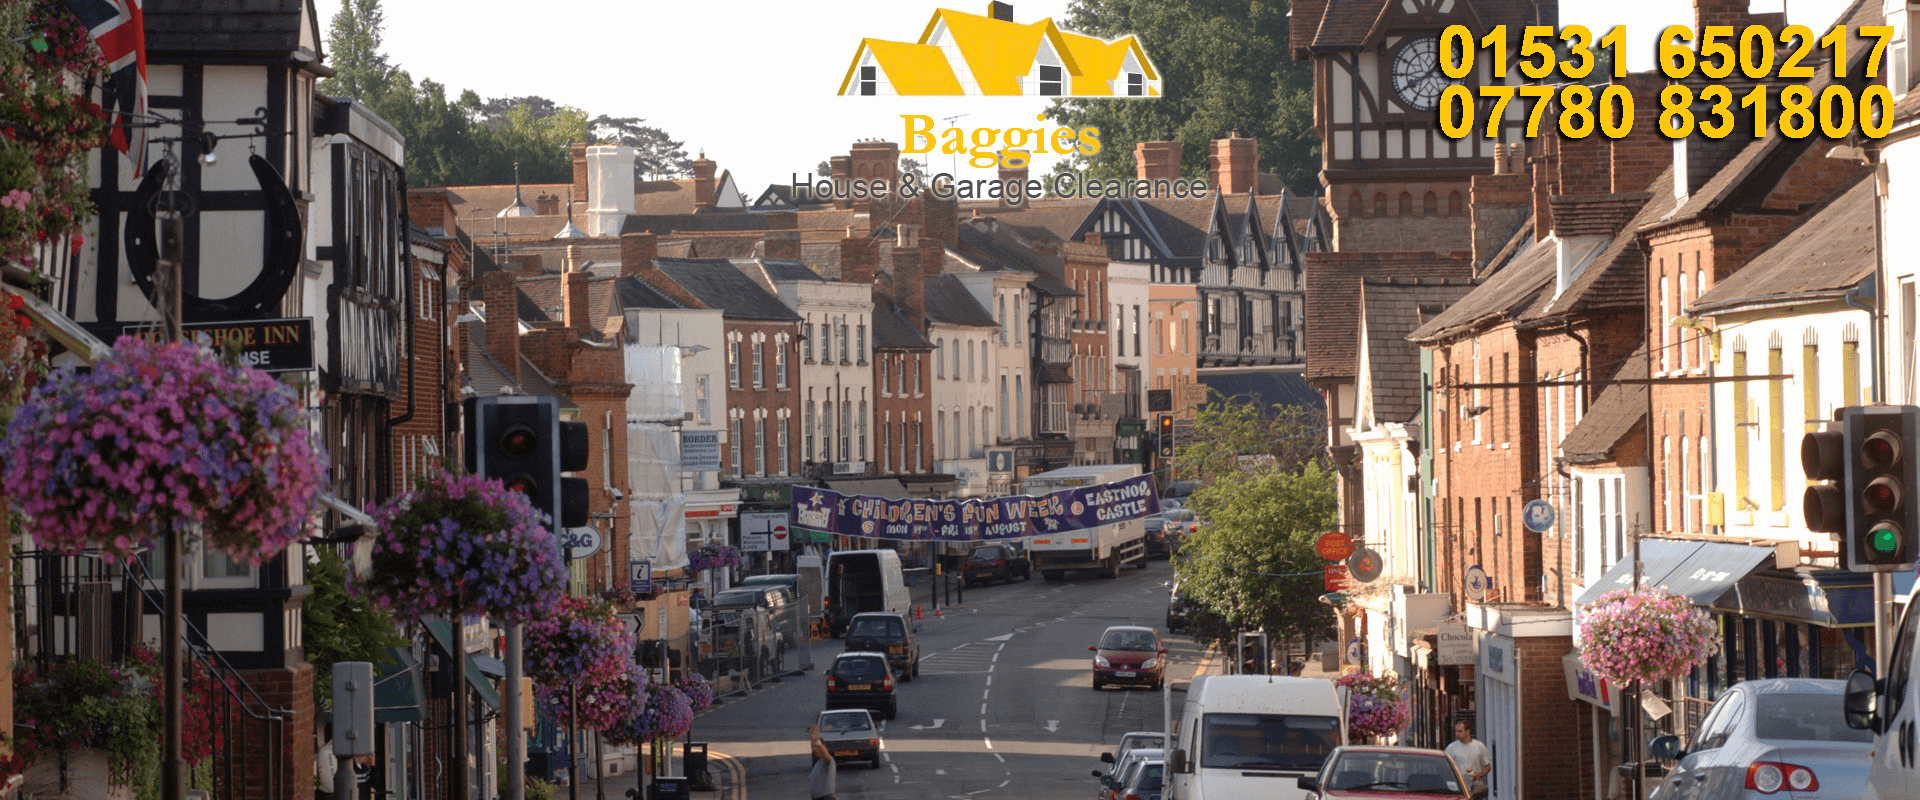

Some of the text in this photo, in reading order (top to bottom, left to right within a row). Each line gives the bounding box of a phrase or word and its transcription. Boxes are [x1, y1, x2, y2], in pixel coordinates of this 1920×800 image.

[136, 324, 300, 347] HOSESHOE INN
[682, 434, 718, 443] BORDER
[1085, 480, 1152, 506] EASTNOR
[962, 503, 999, 524] FUN
[1005, 495, 1064, 519] WEEK
[1096, 499, 1147, 521] CASTLE
[886, 524, 908, 534] MON
[985, 521, 1027, 536] AUGUST
